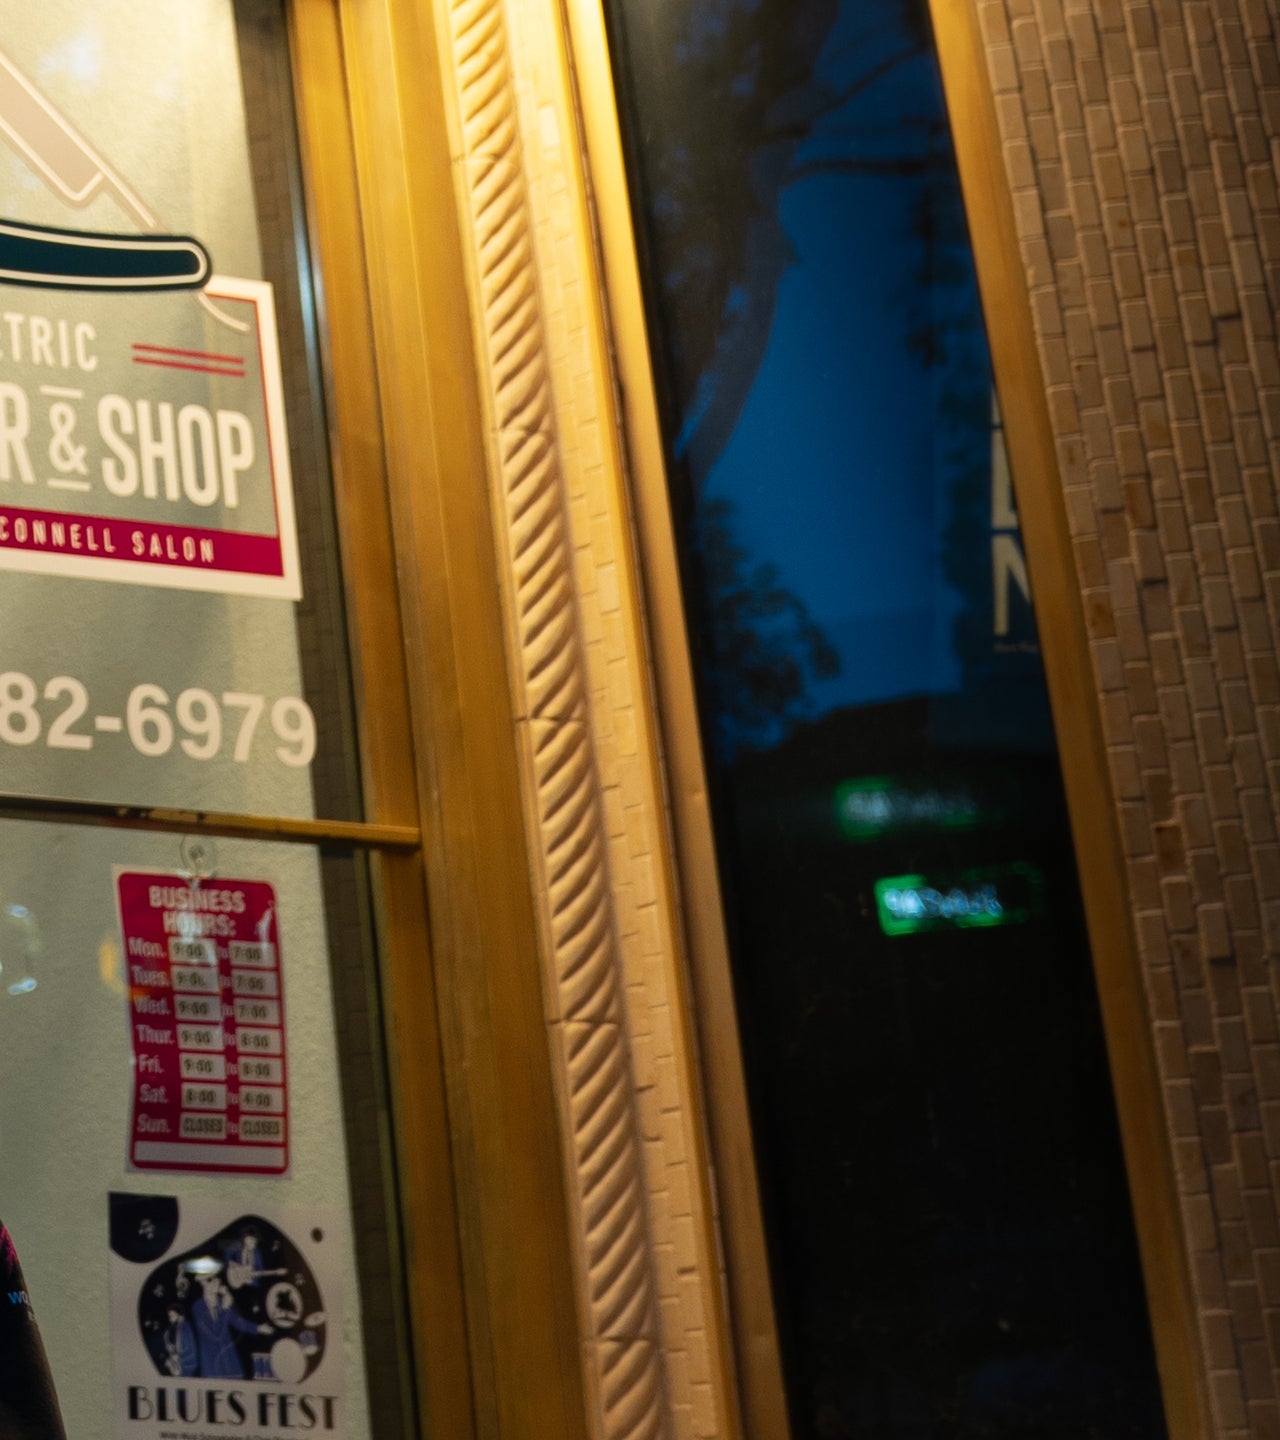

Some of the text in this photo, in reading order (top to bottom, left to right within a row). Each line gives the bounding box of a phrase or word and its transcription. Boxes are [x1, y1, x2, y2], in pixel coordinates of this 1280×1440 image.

[46, 401, 89, 476] &
[96, 392, 256, 510] SHOP
[131, 529, 216, 564] SALON
[148, 885, 246, 913] BUSINESS
[128, 1385, 339, 1430] BLUES FEST
